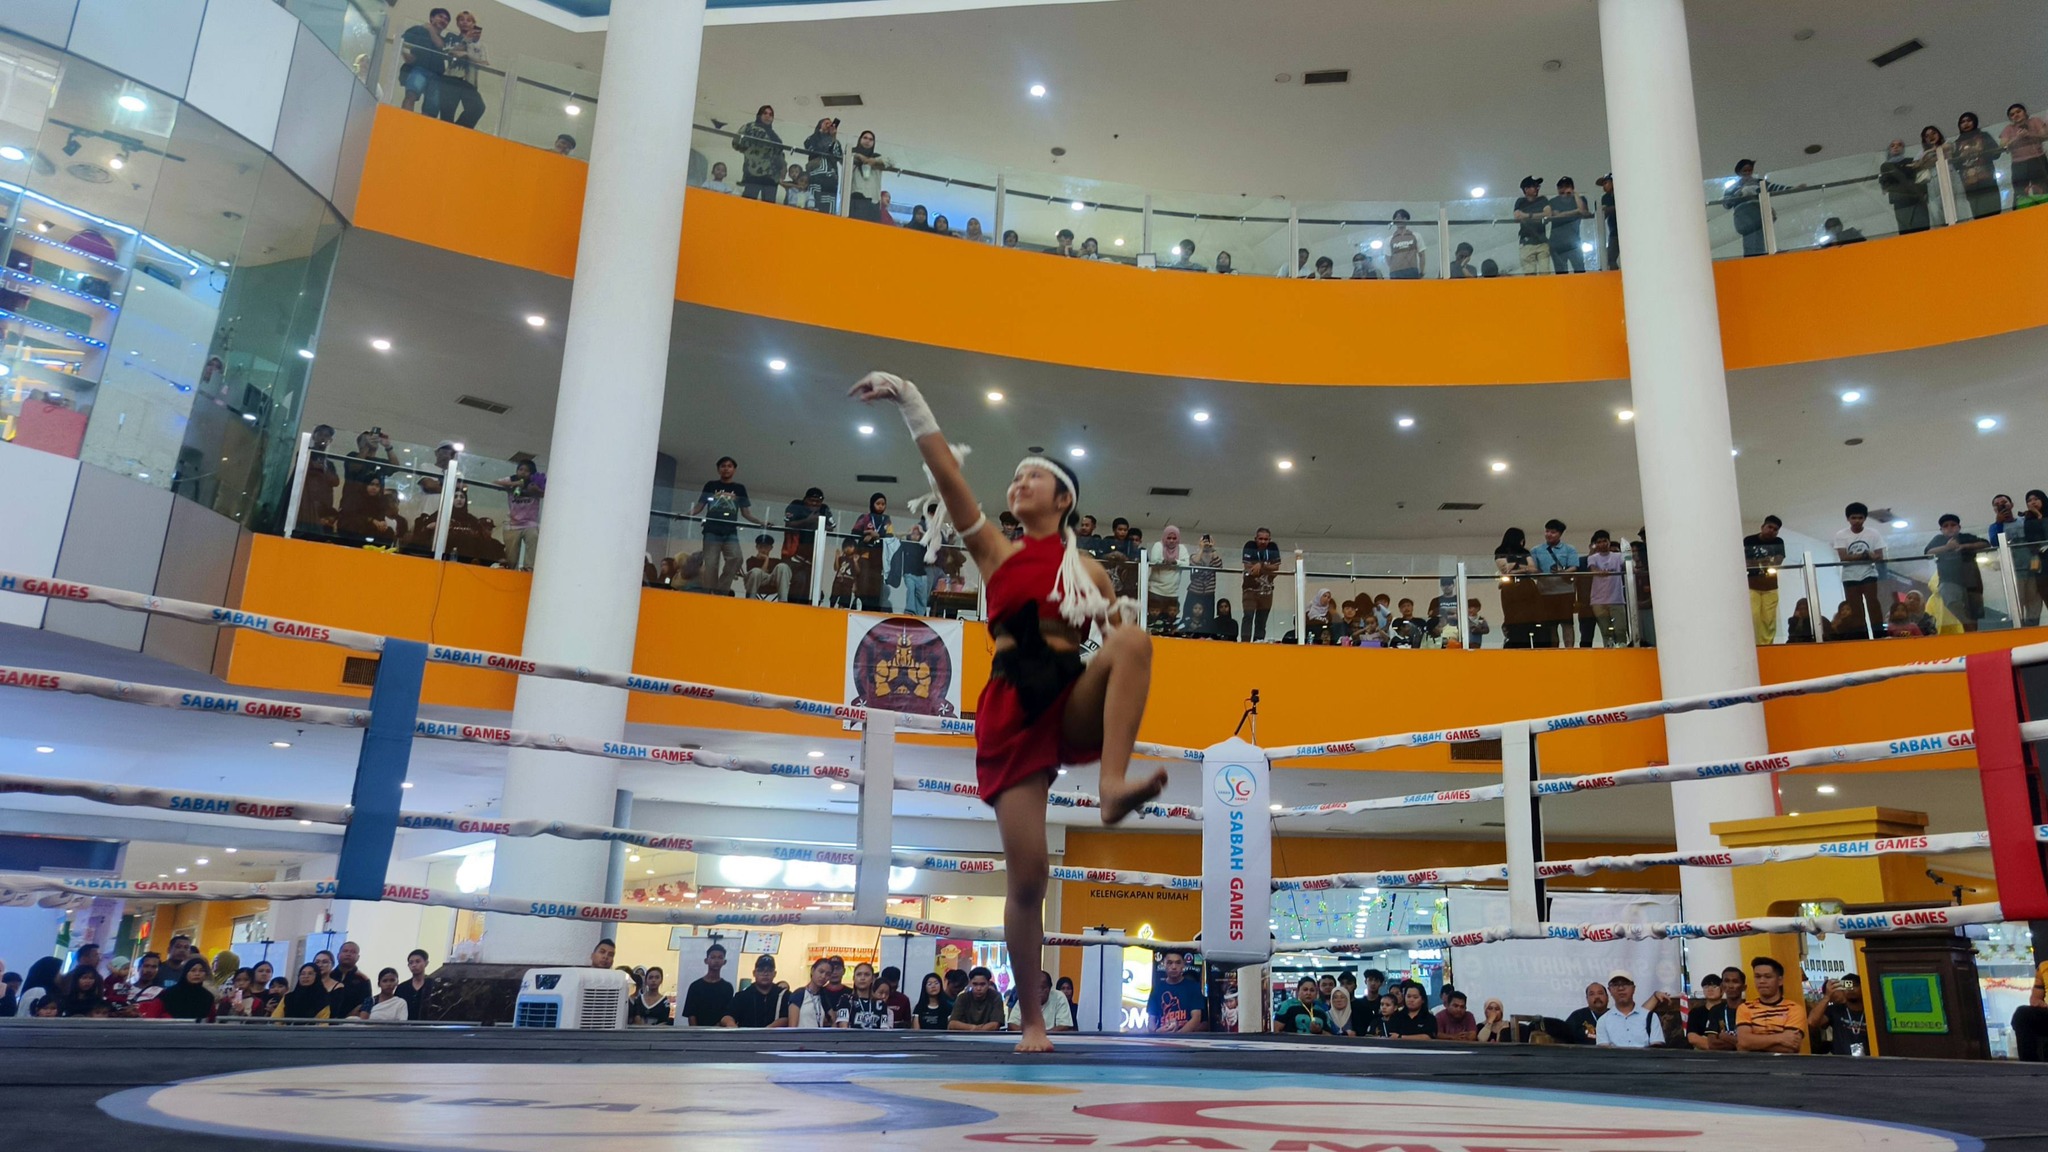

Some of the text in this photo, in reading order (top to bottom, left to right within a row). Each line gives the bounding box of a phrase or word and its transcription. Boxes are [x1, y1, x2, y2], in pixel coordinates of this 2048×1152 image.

[23, 579, 90, 599] GAMES
[212, 608, 330, 641] SABAH GAMES
[433, 647, 536, 673] SABAH GAMES
[626, 676, 715, 698] SABAH GAMES
[181, 693, 302, 718] SABAH GAMES
[793, 700, 867, 720] SABAH GAME
[941, 719, 973, 732] SABAH
[1547, 711, 1628, 730] SABAH GAMES
[413, 723, 511, 741] ABAH GAMES
[1412, 729, 1480, 743] SABAH GAMES
[603, 742, 693, 762] SABAH GAMES
[1296, 743, 1356, 755] SABAH GAMES
[1889, 736, 1942, 754] SABAH
[1184, 749, 1204, 760] SABA
[770, 763, 850, 778] SABAH GAMES
[1697, 756, 1790, 777] SABAH GAMES
[918, 779, 981, 796] SABAH GAM
[1537, 776, 1615, 793] SABAH GAMES
[1403, 790, 1471, 803] SABAH GAMES
[170, 796, 294, 818] SABAH GAMES
[403, 816, 510, 834] SABAH GAMES
[650, 837, 693, 850] GAMES
[1230, 811, 1244, 871] SABAH
[1817, 836, 1928, 853] SABAH GAMES
[773, 847, 854, 863] SABAH GAMES
[1687, 853, 1733, 865] GAMES
[924, 857, 995, 871] SABAH GAMES
[1538, 863, 1574, 876] GAMES
[1053, 867, 1117, 881] SABAH GAMES
[1376, 870, 1438, 884] SABAH GAMES
[134, 880, 198, 891] GAMES
[1171, 878, 1198, 888] SABAH
[1302, 879, 1331, 889] GAMES
[1090, 889, 1189, 901] KELENGKAPAN RUMAH
[530, 902, 628, 920] SABAH GAMES
[1230, 877, 1244, 941] GAMES
[715, 912, 801, 924] SABAH GAMES
[884, 916, 951, 936] ABAH GAMES
[1836, 911, 1948, 930] SABAH GAMES
[1665, 921, 1753, 936] SABAH GAMES
[1417, 932, 1483, 949] SABAH GAMES
[221, 1088, 783, 1116] SABAH
[963, 1132, 1688, 1152] GAM
